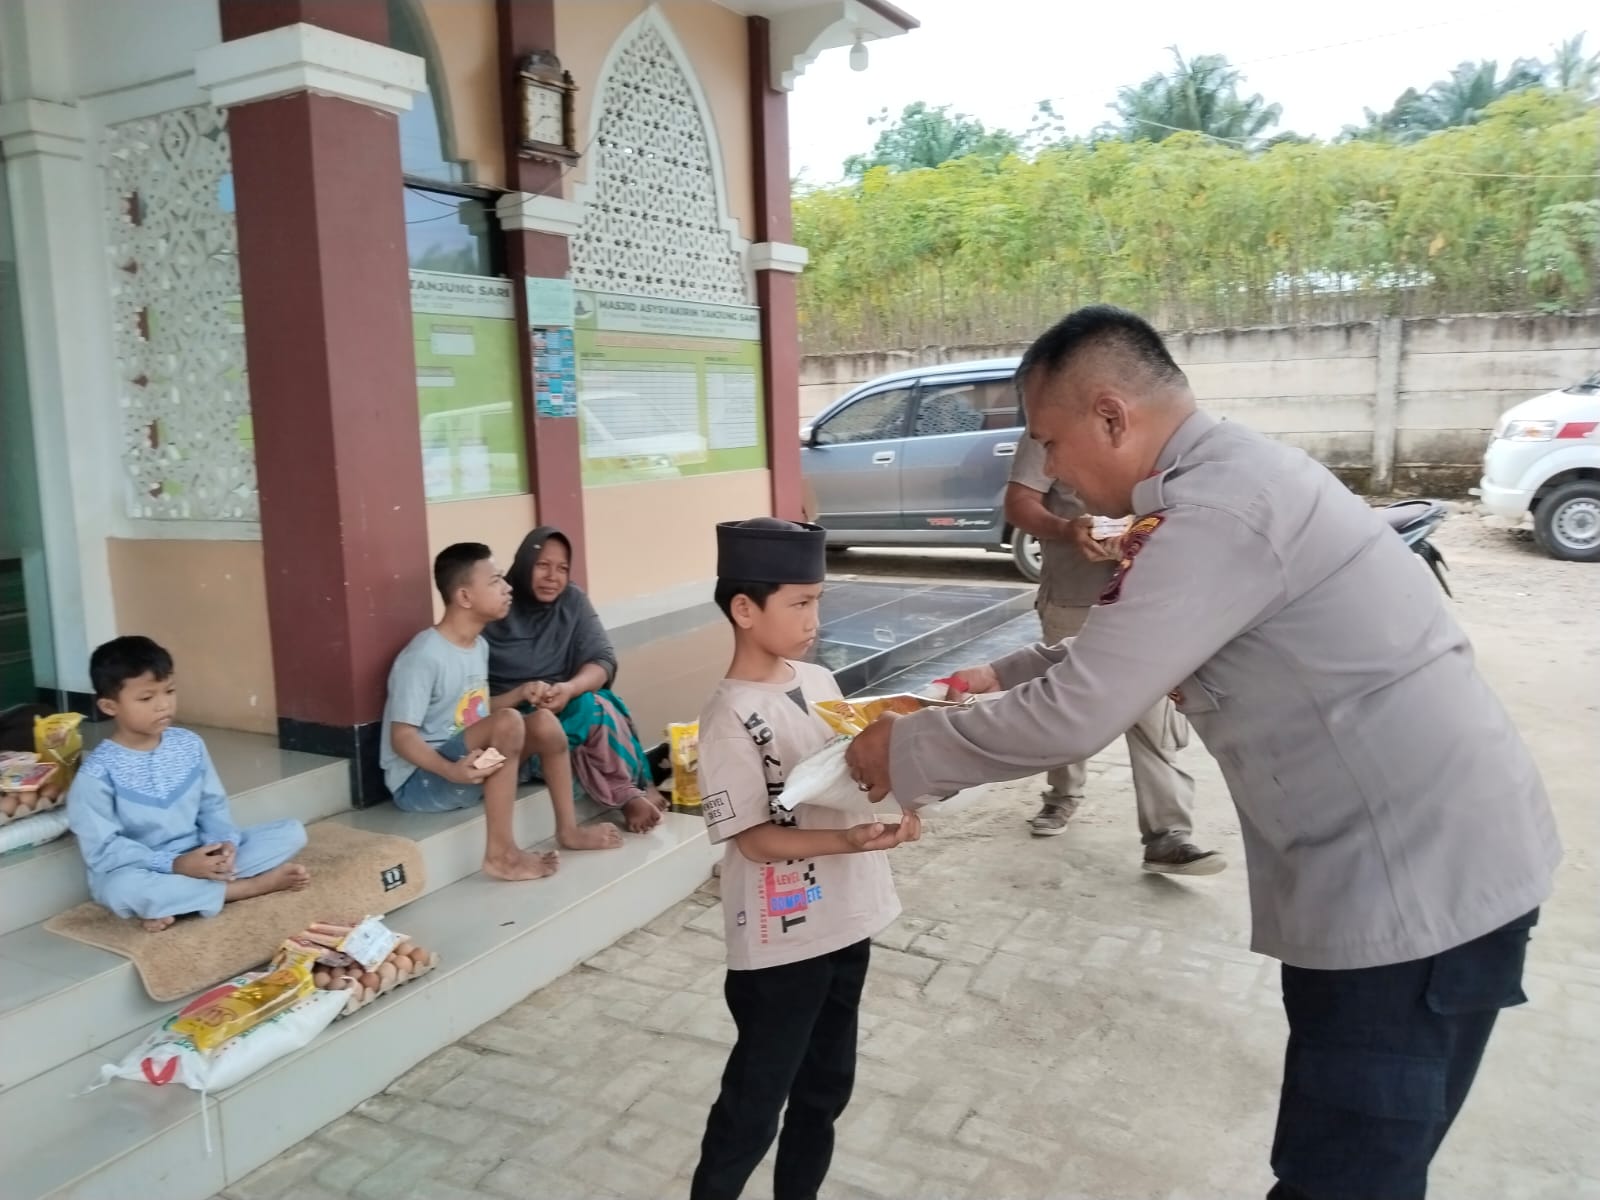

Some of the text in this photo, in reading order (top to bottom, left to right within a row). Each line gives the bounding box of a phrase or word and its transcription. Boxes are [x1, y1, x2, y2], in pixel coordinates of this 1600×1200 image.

[479, 285, 510, 298] SARI
[600, 301, 636, 313] MASJID
[776, 871, 801, 886] LEVEL
[770, 885, 822, 912] COMPLETE
